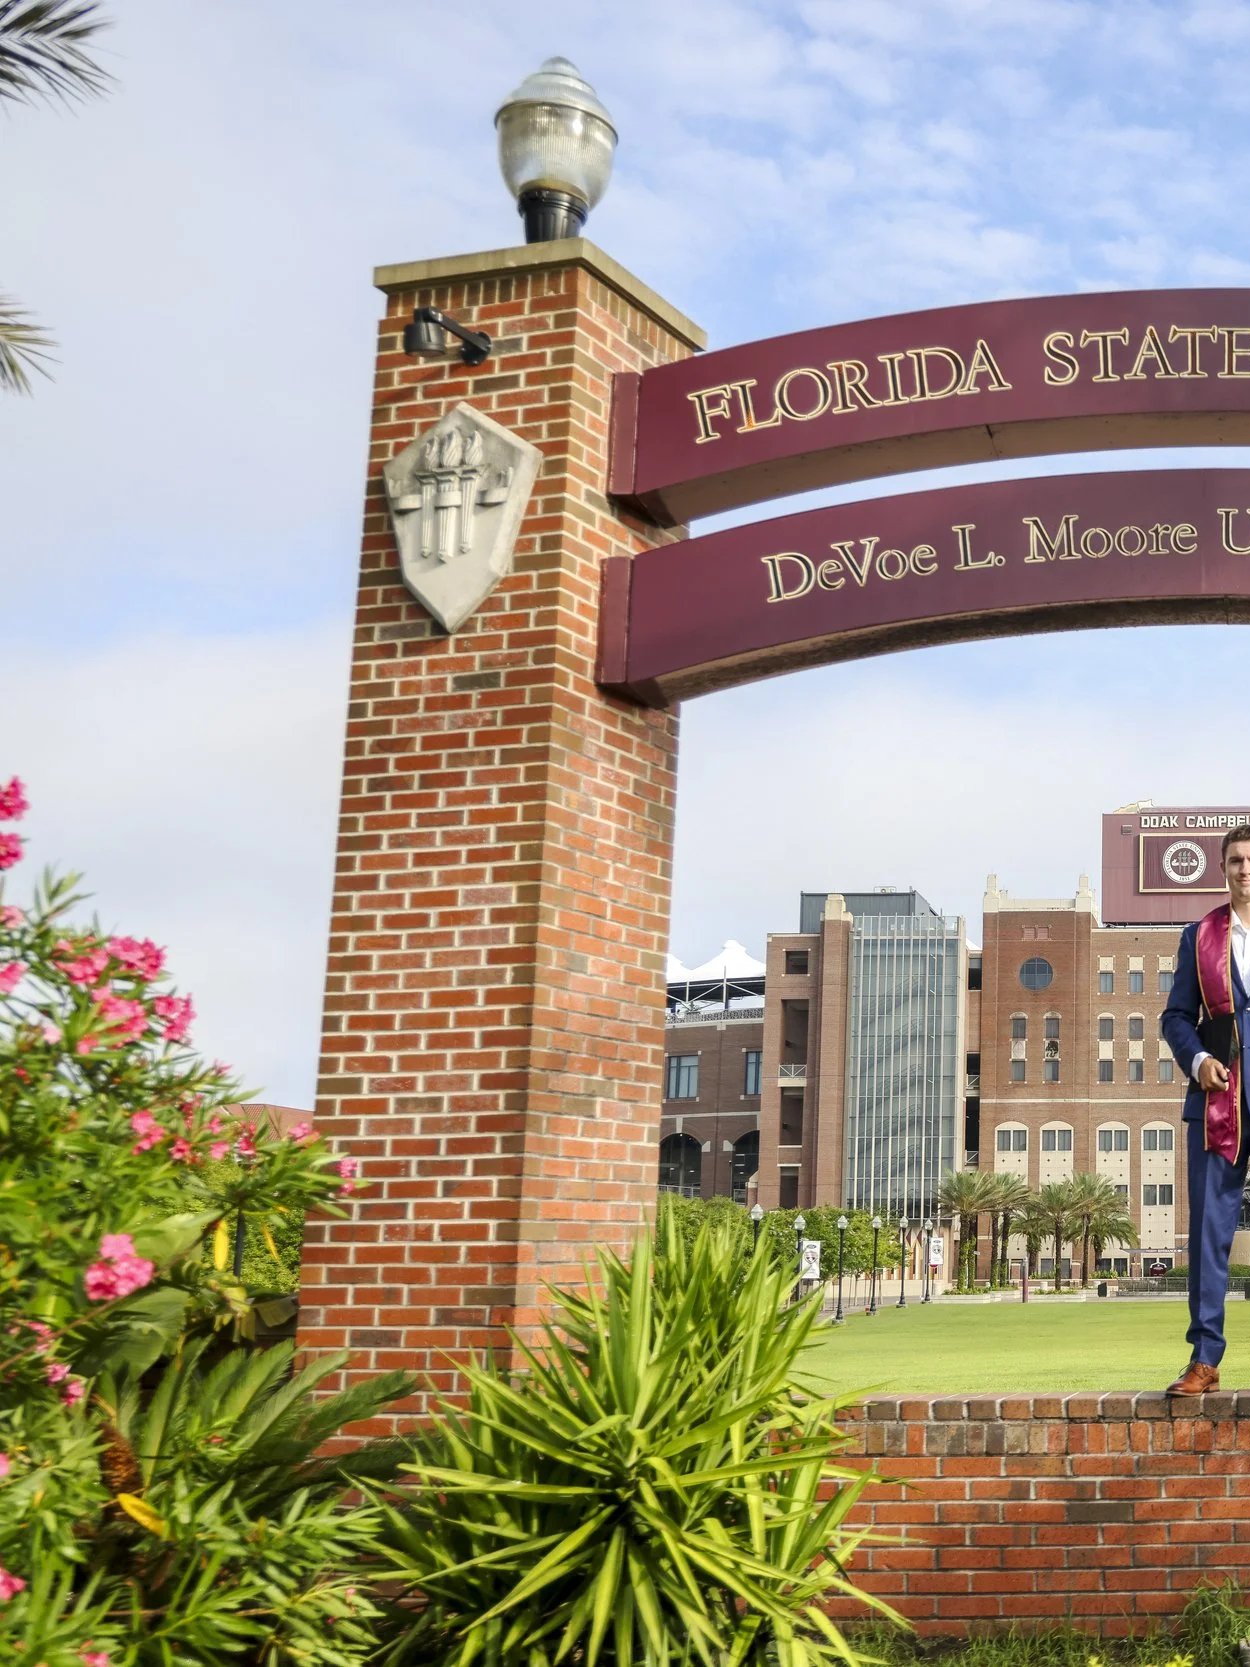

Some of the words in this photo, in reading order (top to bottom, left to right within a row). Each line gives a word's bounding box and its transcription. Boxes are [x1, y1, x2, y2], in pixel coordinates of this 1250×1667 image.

[687, 338, 1013, 444] FLORIDA
[761, 535, 939, 603] DeVoe
[952, 523, 1006, 572] L.
[1023, 513, 1199, 564] Moore
[1140, 815, 1179, 828] DOAK
